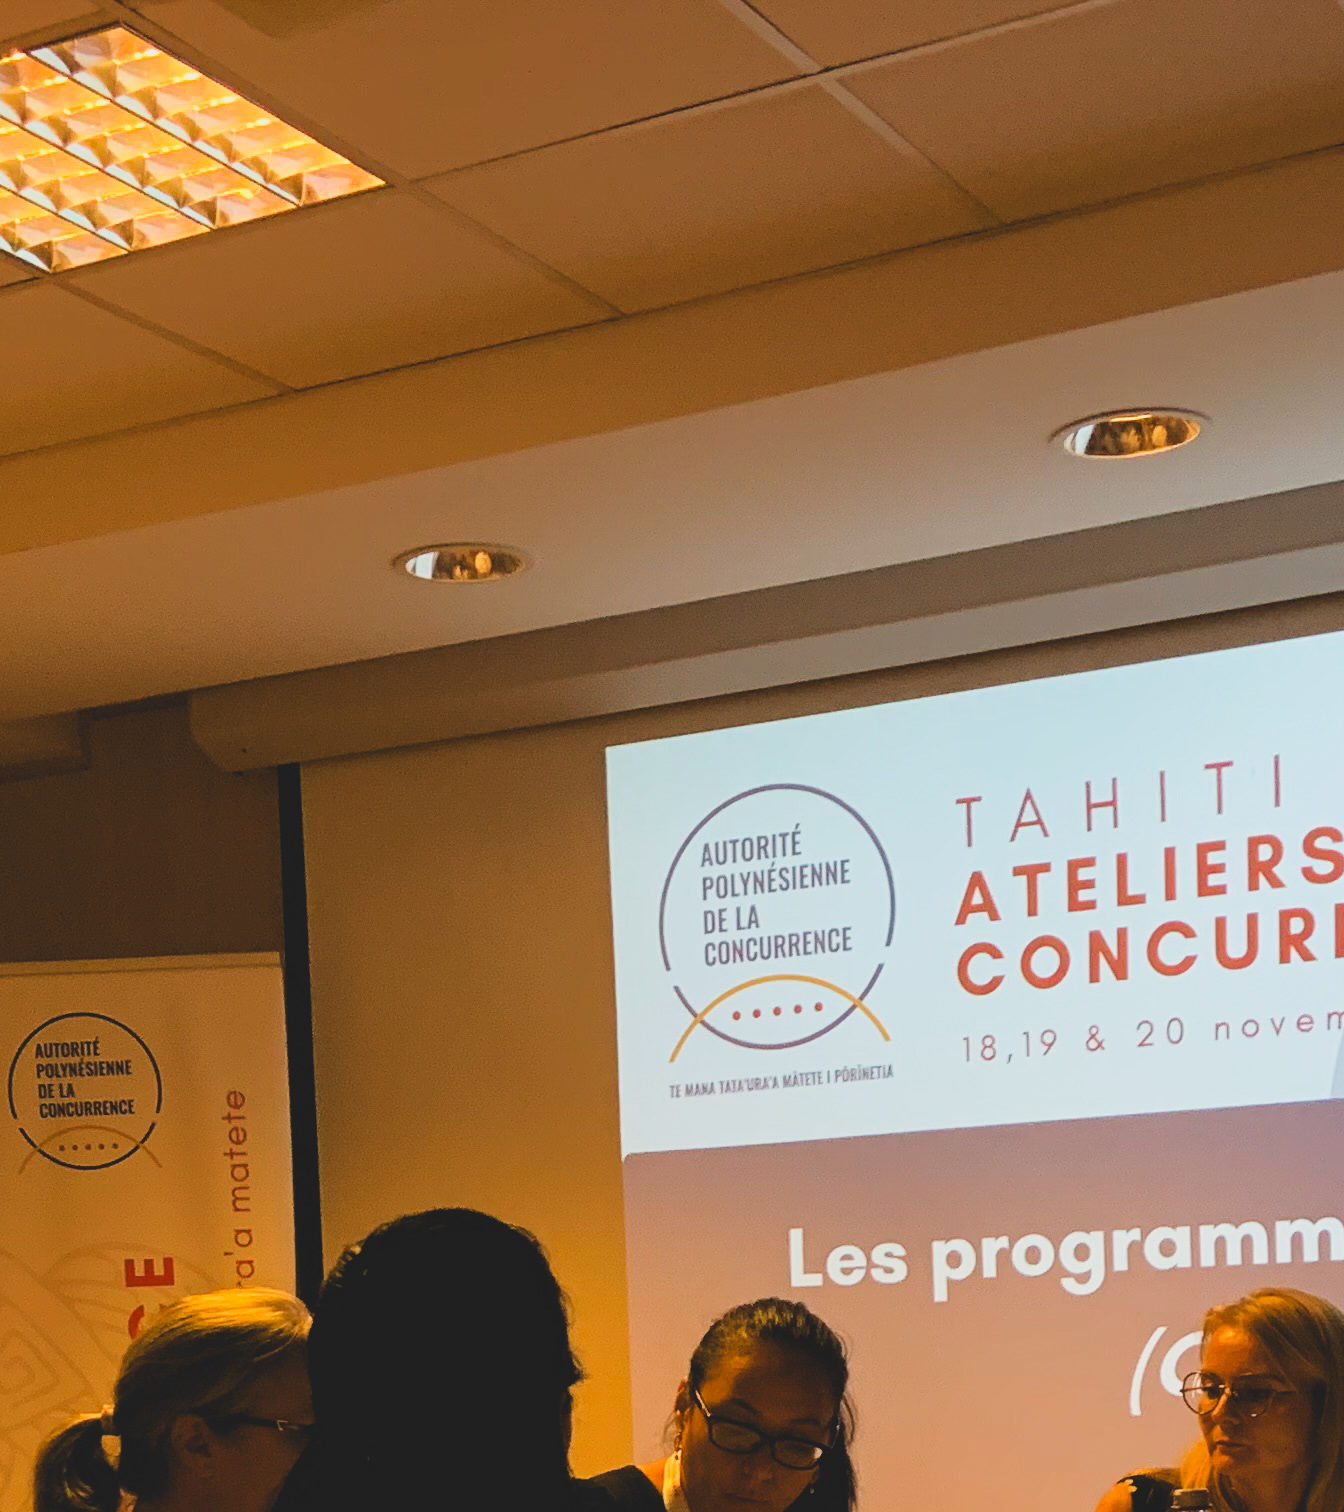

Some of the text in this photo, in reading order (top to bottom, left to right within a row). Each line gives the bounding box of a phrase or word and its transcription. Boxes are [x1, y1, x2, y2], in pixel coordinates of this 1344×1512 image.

[956, 755, 1281, 847] TAHITI
[701, 823, 802, 868] AUTORITÉ
[702, 859, 851, 901] POLYNÉSIENNE
[703, 904, 760, 935] DE LA
[704, 926, 853, 967] CONCURRENCE
[35, 1036, 101, 1059] AUTORITÉ
[1085, 1025, 1106, 1052] &
[1136, 1017, 1186, 1047] 20
[36, 1058, 133, 1079] POLYNÉSIENNE
[38, 1082, 75, 1099] DE LA
[669, 1084, 682, 1099] TE
[39, 1099, 136, 1119] CONCURRENCE
[222, 1089, 251, 1213] matete
[788, 1227, 908, 1288] Les
